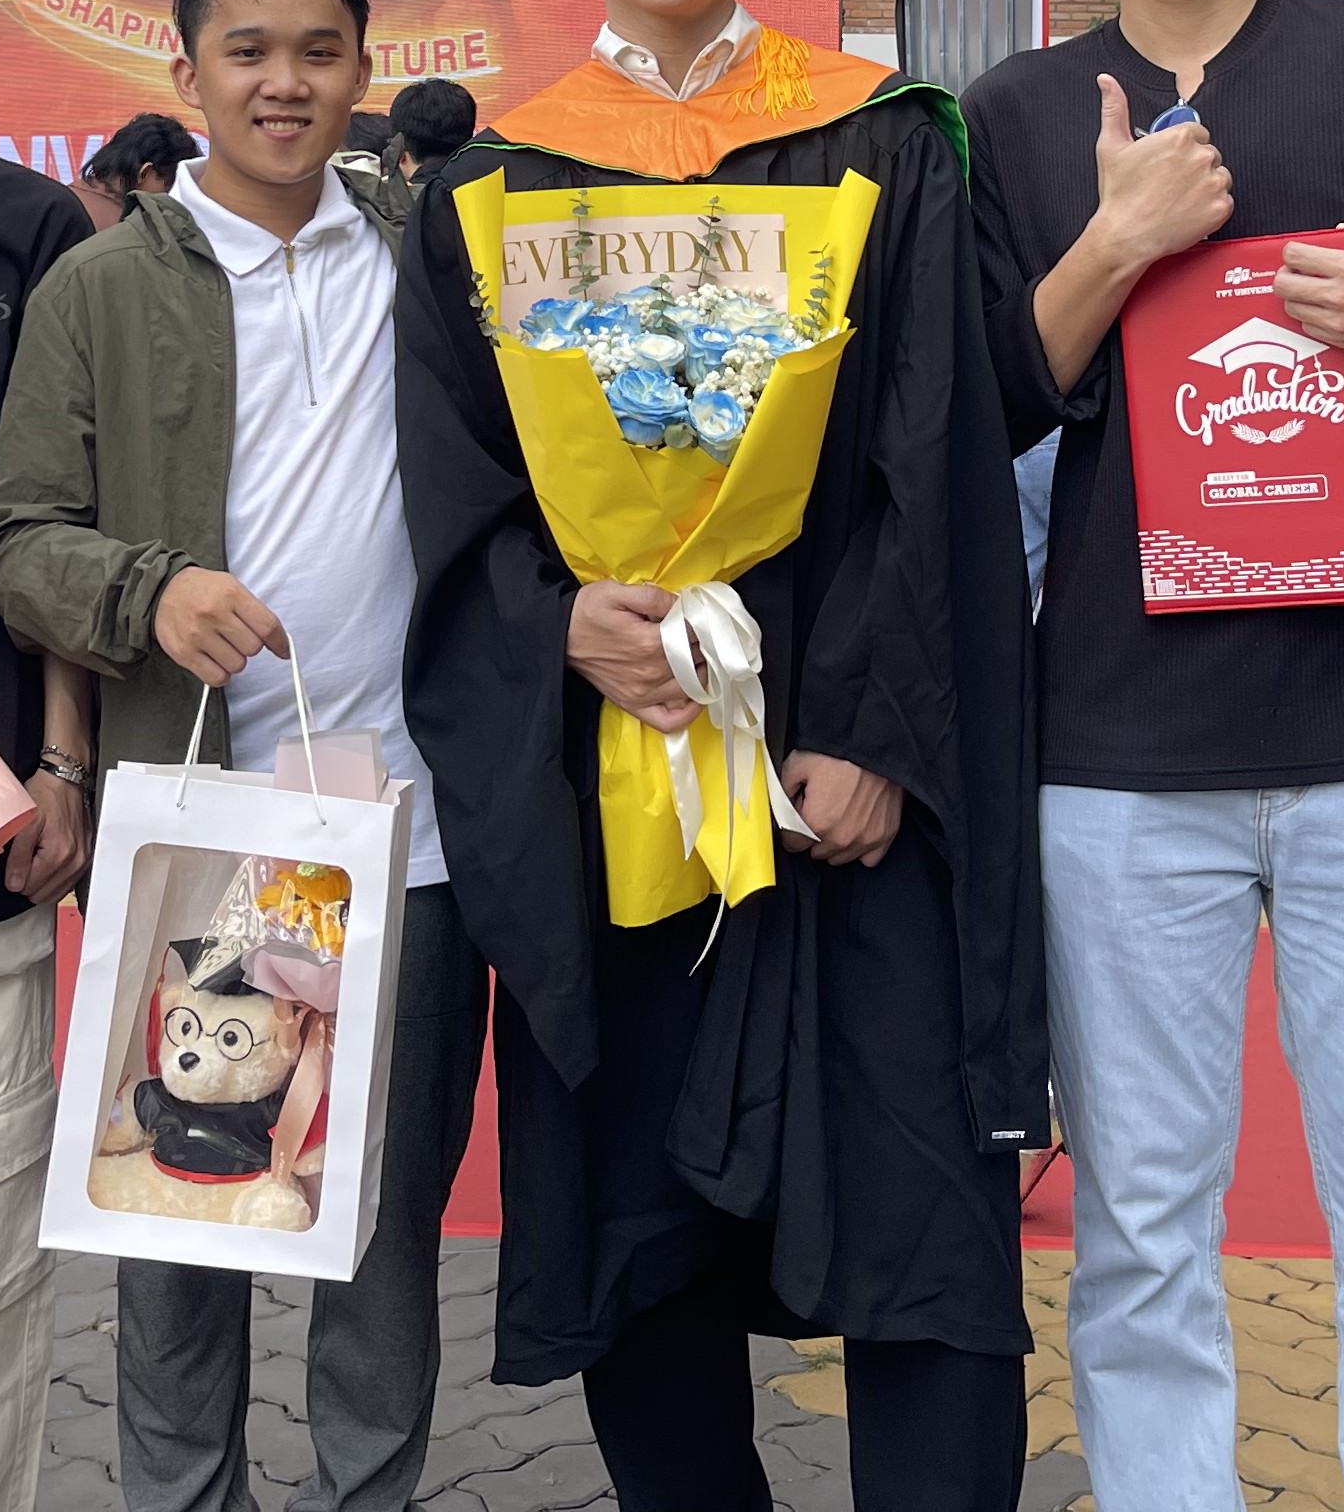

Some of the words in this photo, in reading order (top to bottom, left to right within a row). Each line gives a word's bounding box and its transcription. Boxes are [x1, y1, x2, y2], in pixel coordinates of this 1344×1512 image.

[364, 31, 490, 78] TURE
[1208, 486, 1263, 499] GLOBAL
[1264, 482, 1319, 496] CAREER
